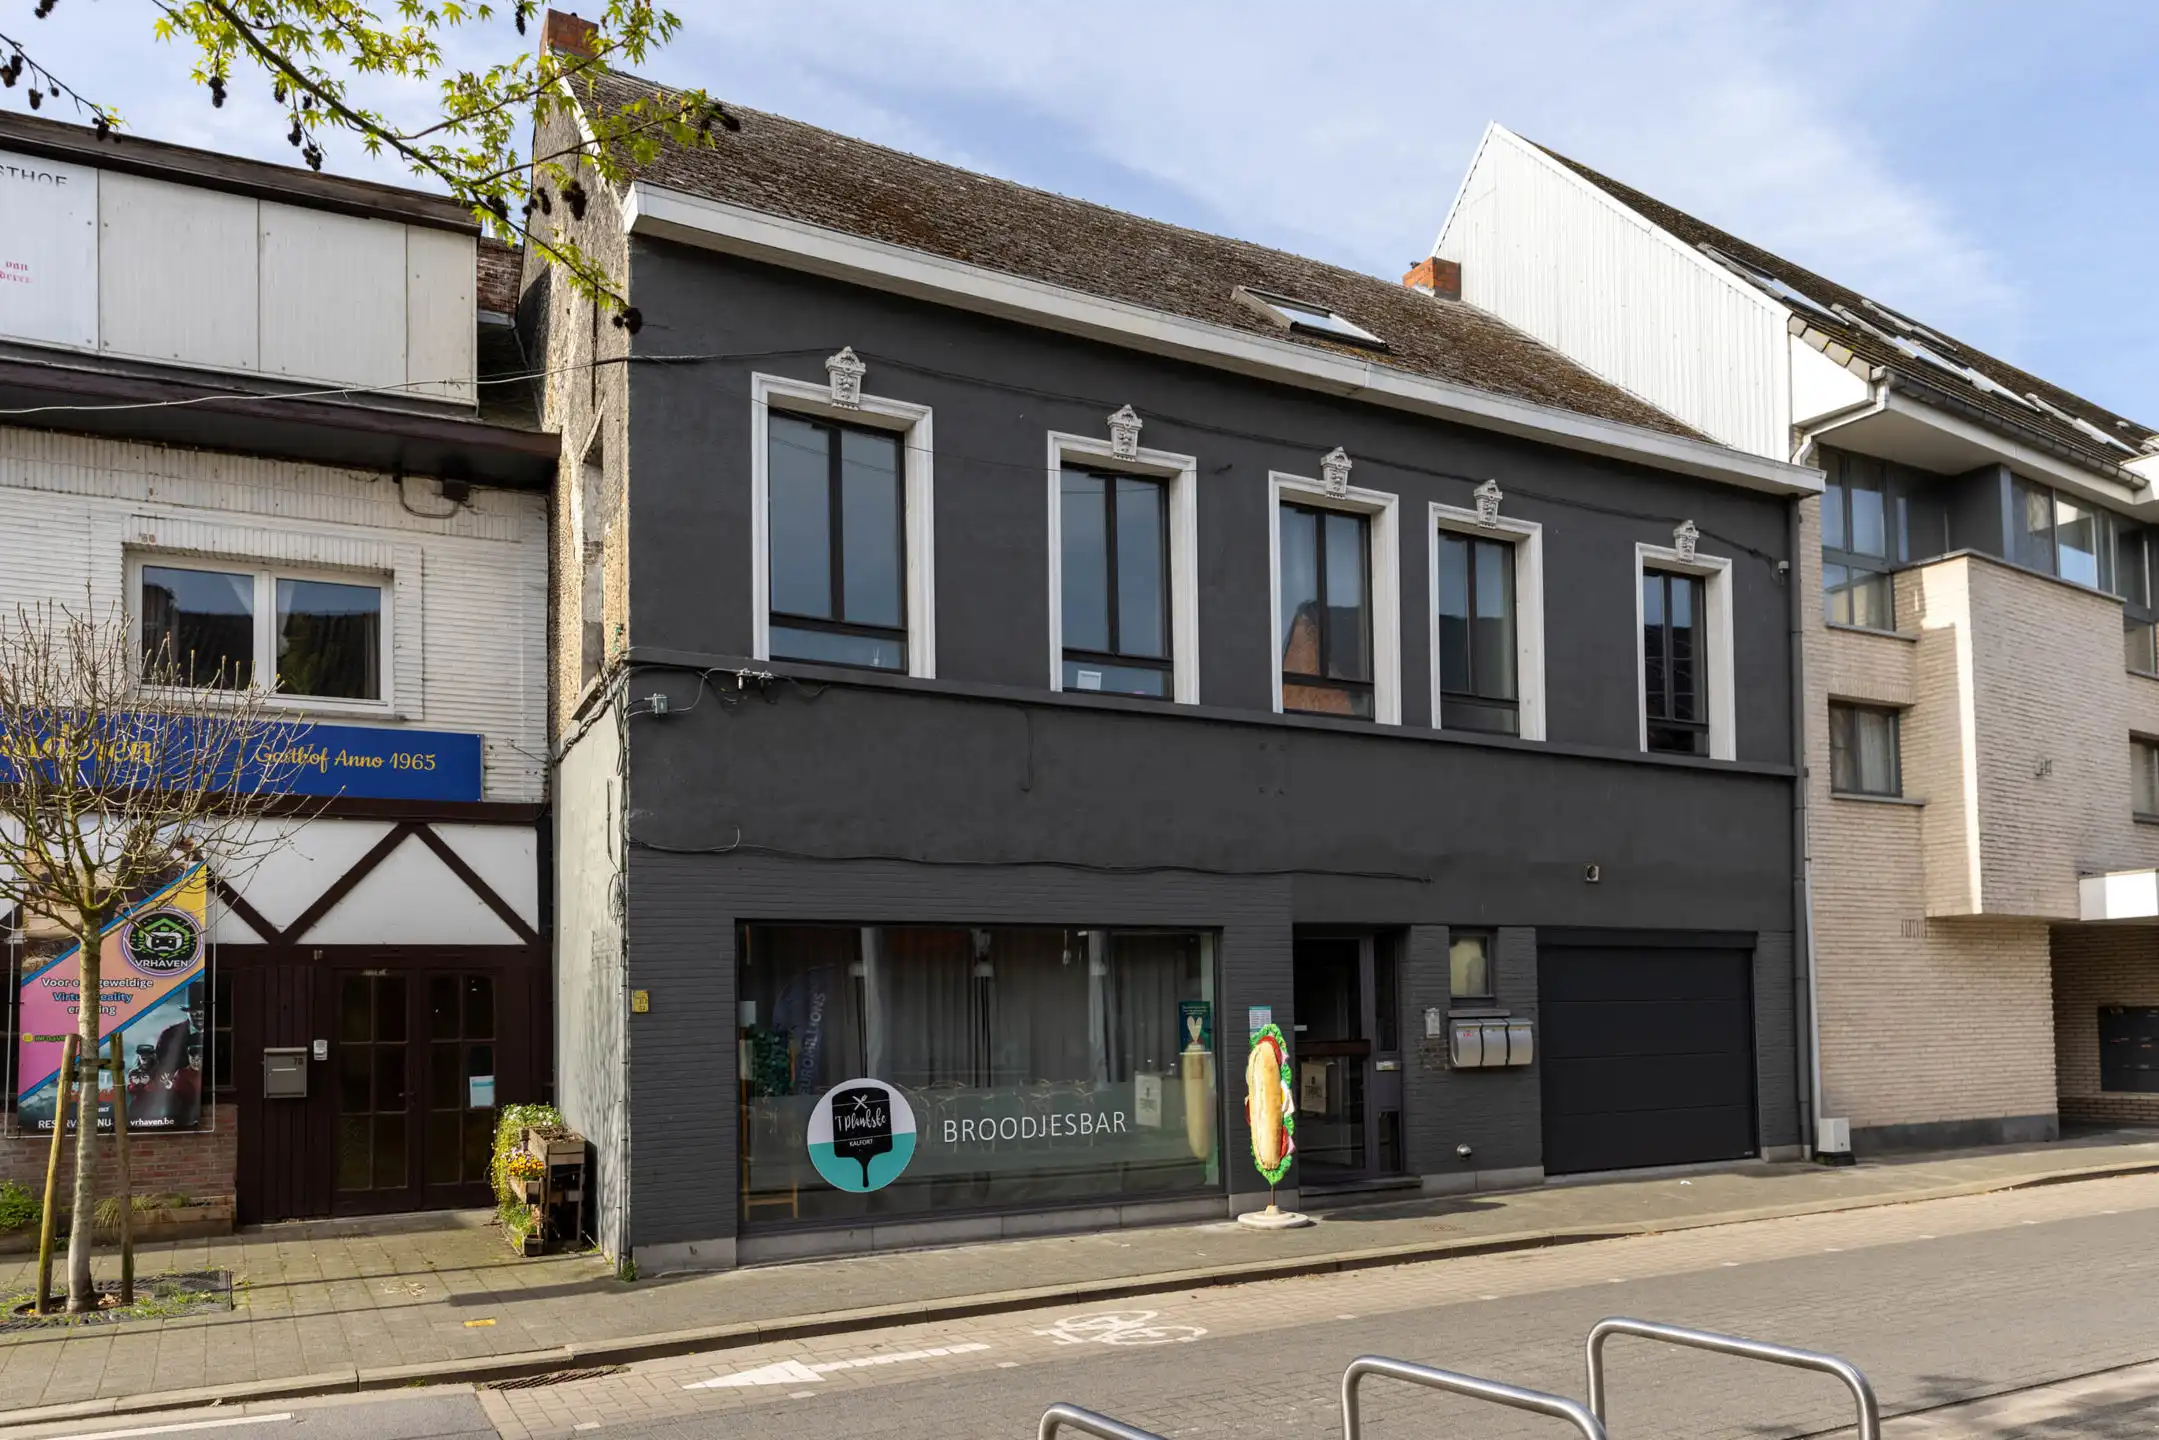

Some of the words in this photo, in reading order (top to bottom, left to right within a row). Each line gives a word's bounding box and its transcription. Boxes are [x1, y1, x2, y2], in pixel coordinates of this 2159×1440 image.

[255, 745, 330, 773] Gasthof
[333, 749, 384, 768] Anno
[390, 752, 437, 771] 1965
[134, 959, 188, 968] VRHAVEN
[42, 978, 70, 988] Voor
[52, 992, 81, 1001] Virtu
[99, 992, 134, 1003] eality
[130, 1117, 175, 1127] vrhaven.be
[943, 1111, 1127, 1143] BROODJESBAR
[849, 1138, 873, 1147] KALFORT
